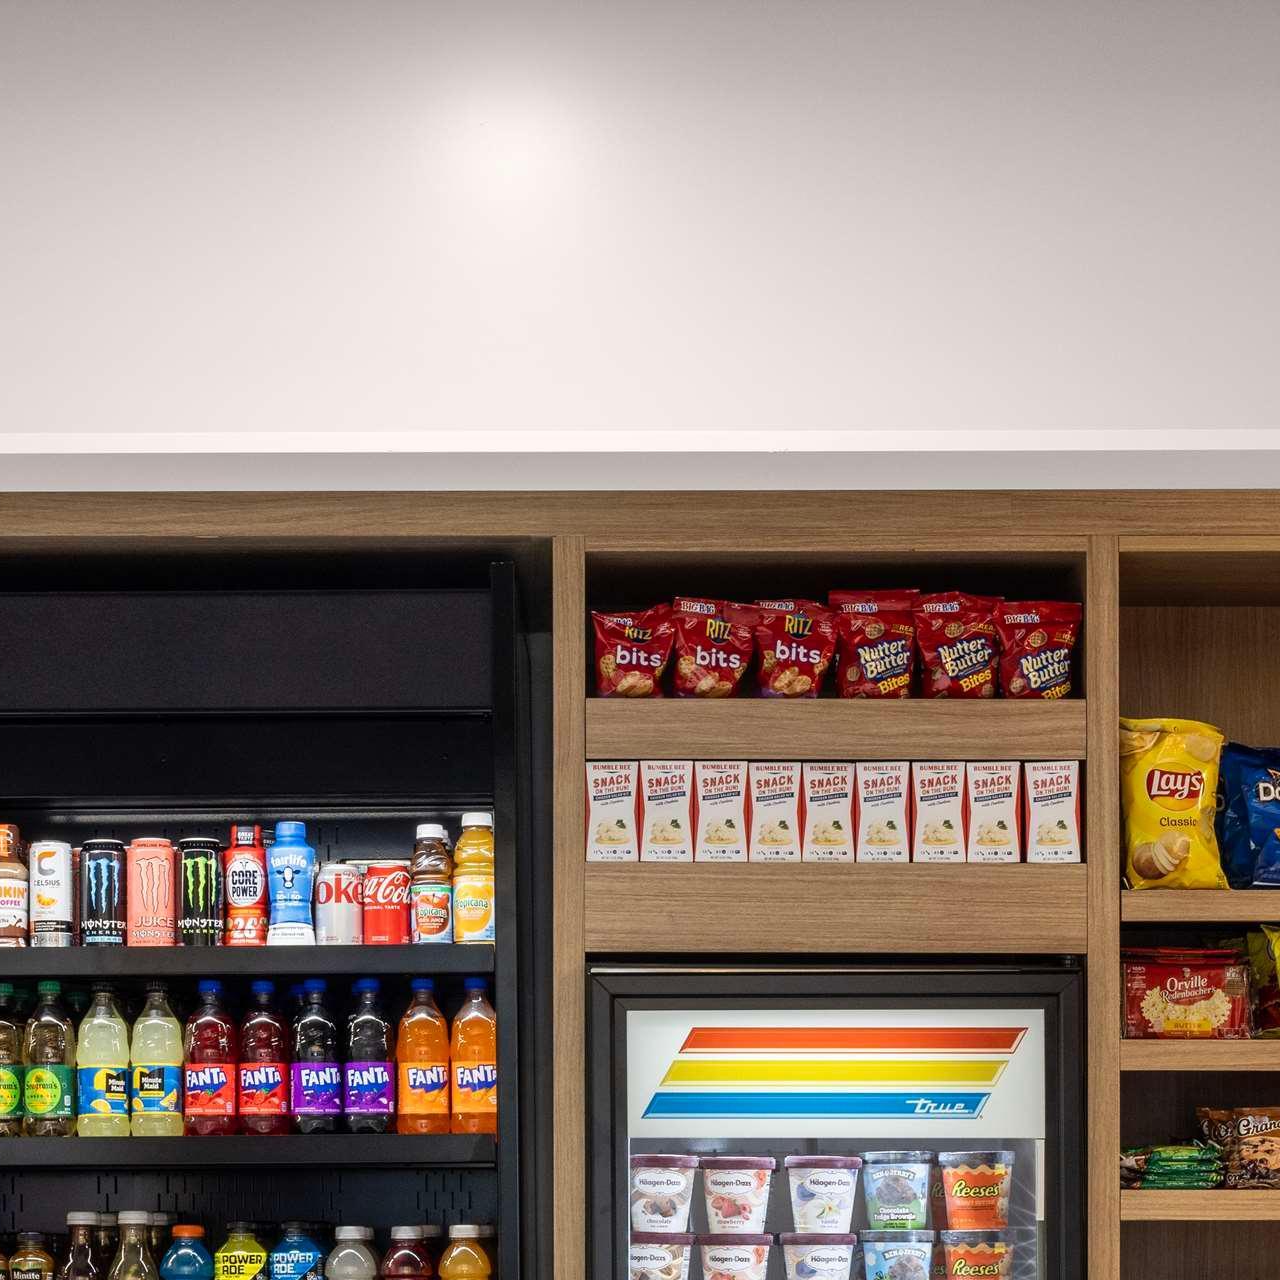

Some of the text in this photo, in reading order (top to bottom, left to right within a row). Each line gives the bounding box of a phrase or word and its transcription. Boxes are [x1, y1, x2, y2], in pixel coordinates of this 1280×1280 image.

[706, 619, 732, 640] RITZ
[785, 615, 813, 635] RITZ
[616, 645, 662, 667] bits
[695, 646, 740, 669] bits
[776, 640, 821, 663] bits
[858, 640, 905, 663] Nutter
[939, 638, 986, 663] Nutter
[865, 652, 911, 677] Butter
[946, 650, 992, 675] Butter
[877, 673, 910, 694] Bites
[960, 670, 991, 692] Bites
[593, 774, 631, 788] SNACK
[648, 774, 685, 788] SNACK
[702, 773, 740, 788] SNACK
[756, 775, 793, 789] SNACK
[1151, 769, 1202, 800] Lay's
[271, 856, 307, 868] fairlife
[232, 872, 258, 885] CORE
[232, 886, 258, 898] POWER
[82, 919, 126, 929] MONSTER
[135, 916, 174, 928] JUICE
[1167, 976, 1207, 990] Orville
[1161, 987, 1216, 1001] Redenbacher's
[952, 1180, 999, 1197] Reese's
[222, 1255, 262, 1264] POWER
[274, 1254, 313, 1263] POWER
[953, 1259, 999, 1275] Reese's
